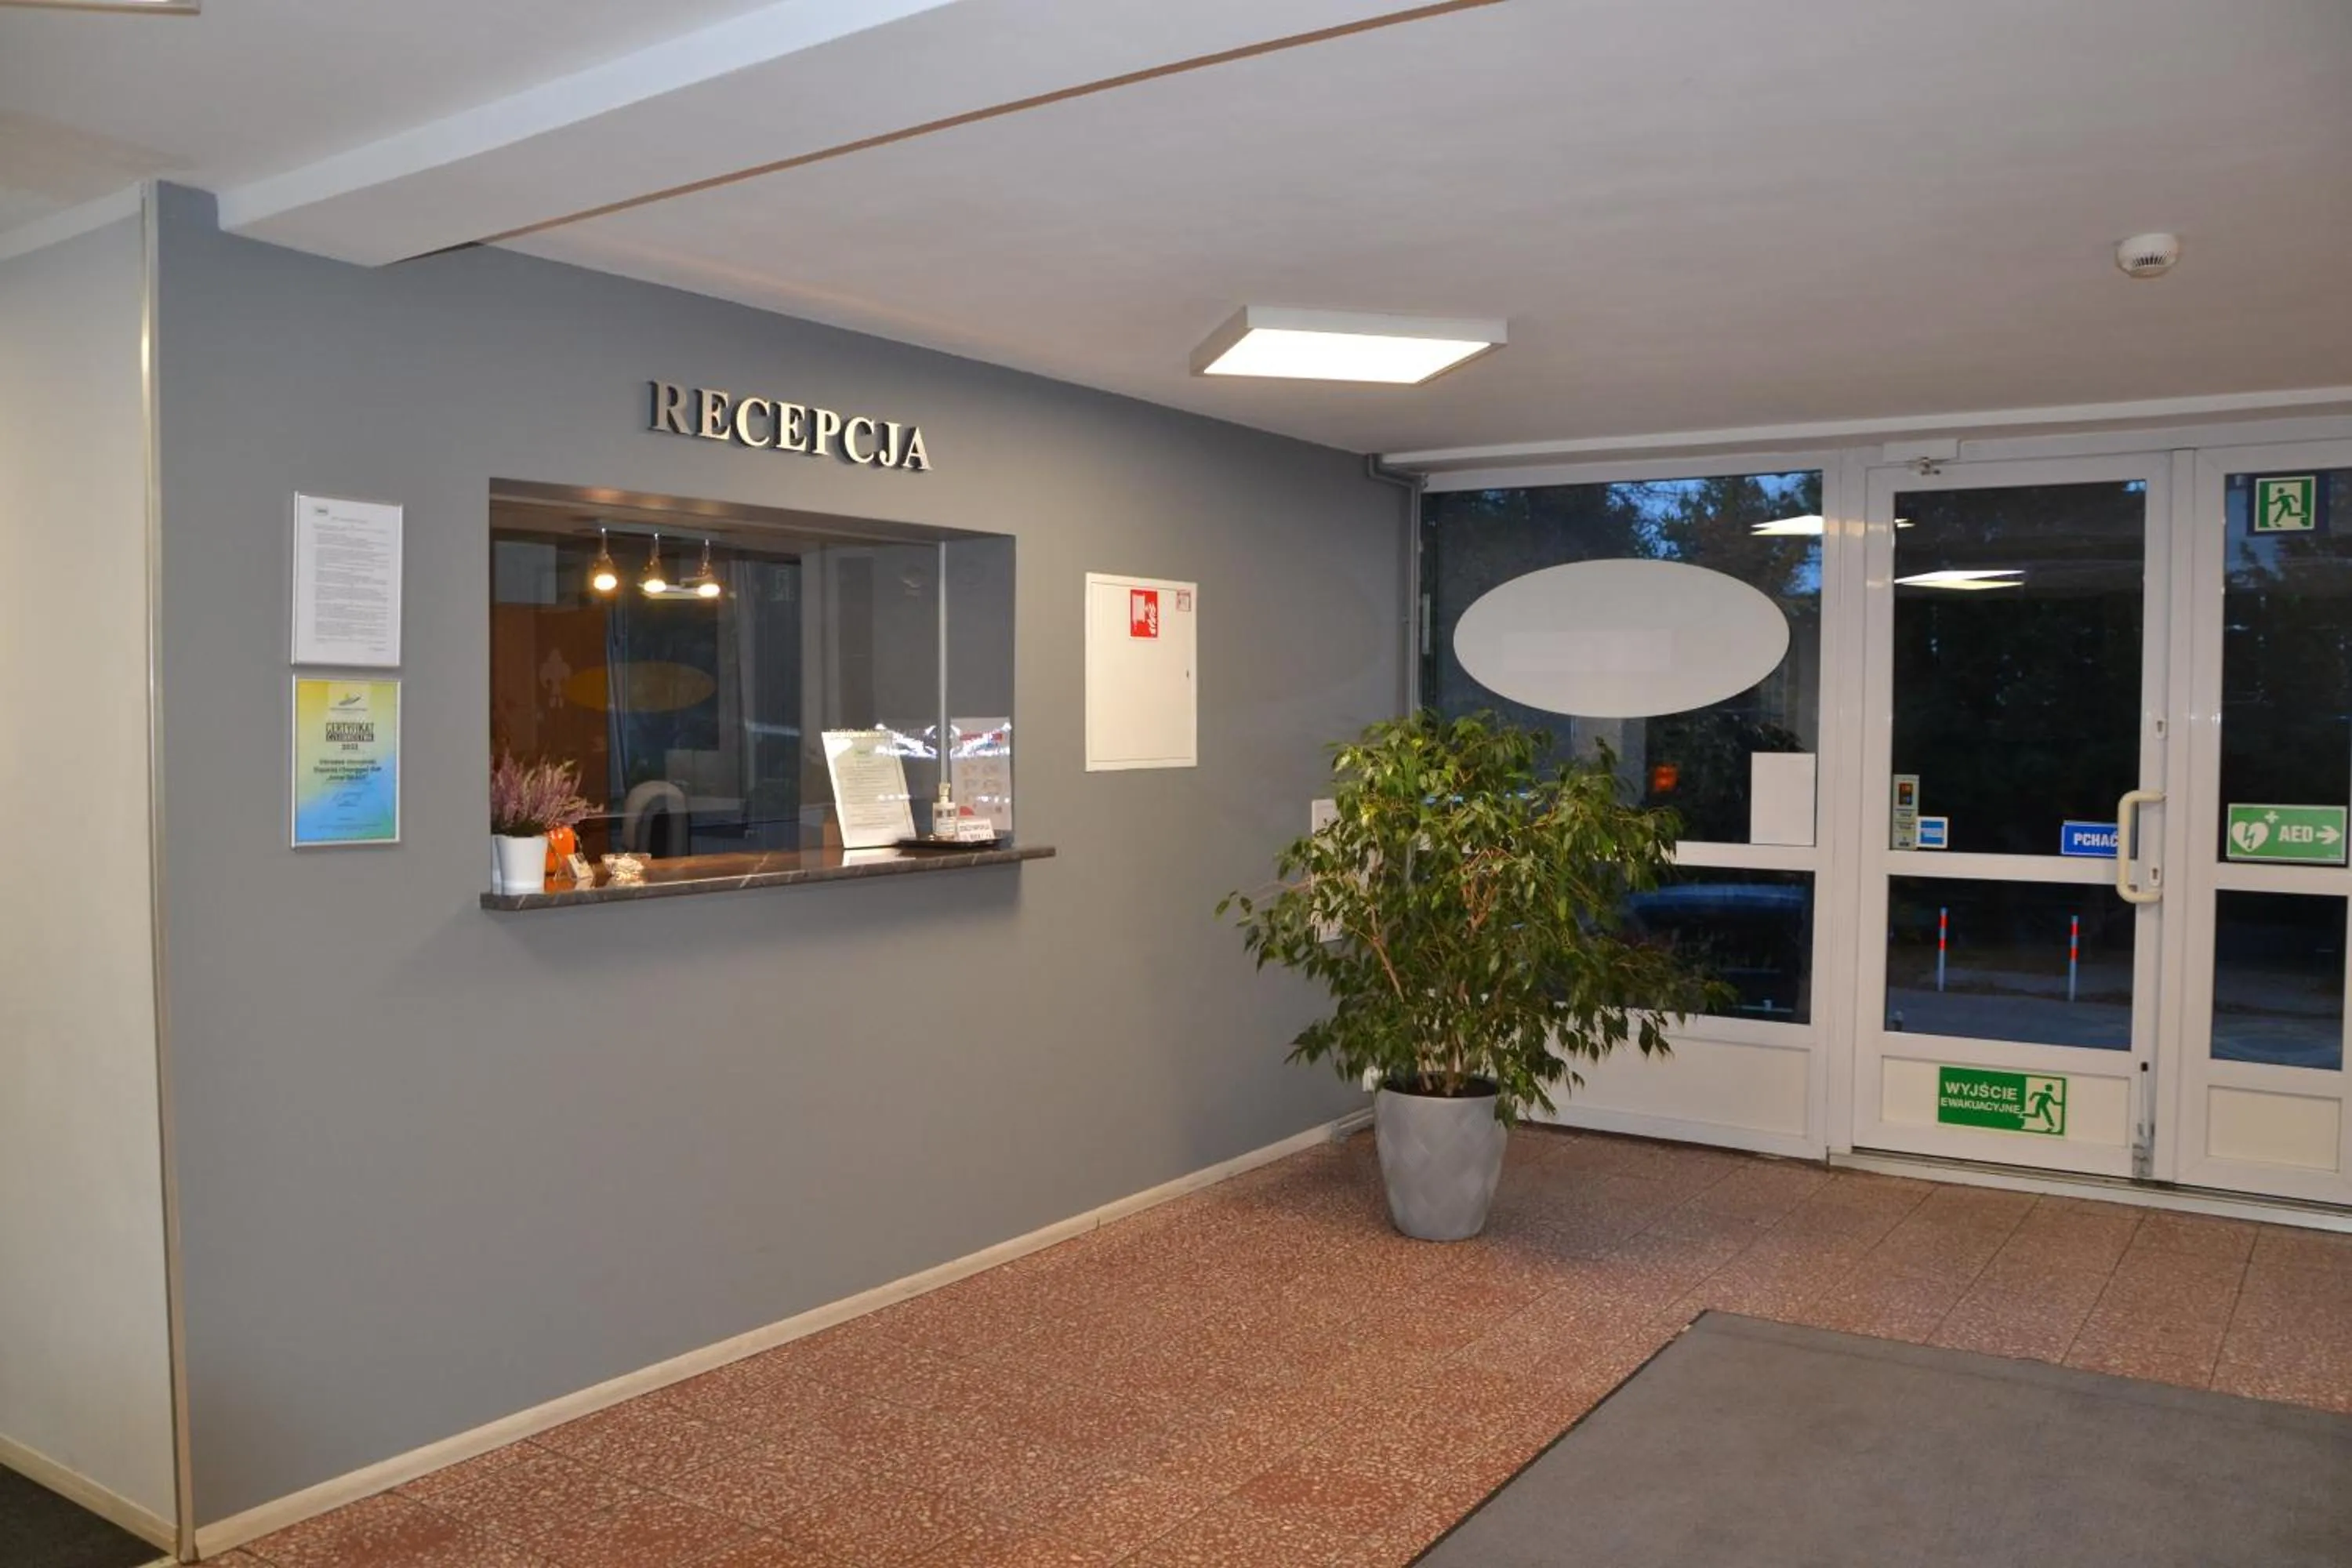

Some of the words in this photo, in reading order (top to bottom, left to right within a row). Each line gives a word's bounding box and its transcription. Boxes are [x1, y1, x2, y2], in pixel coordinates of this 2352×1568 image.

[648, 379, 933, 472] RECEPCJA
[2278, 825, 2313, 843] AED
[1945, 1081, 2018, 1100] WYJŚCIE
[1940, 1098, 2020, 1114] EWAKUACYJNE
